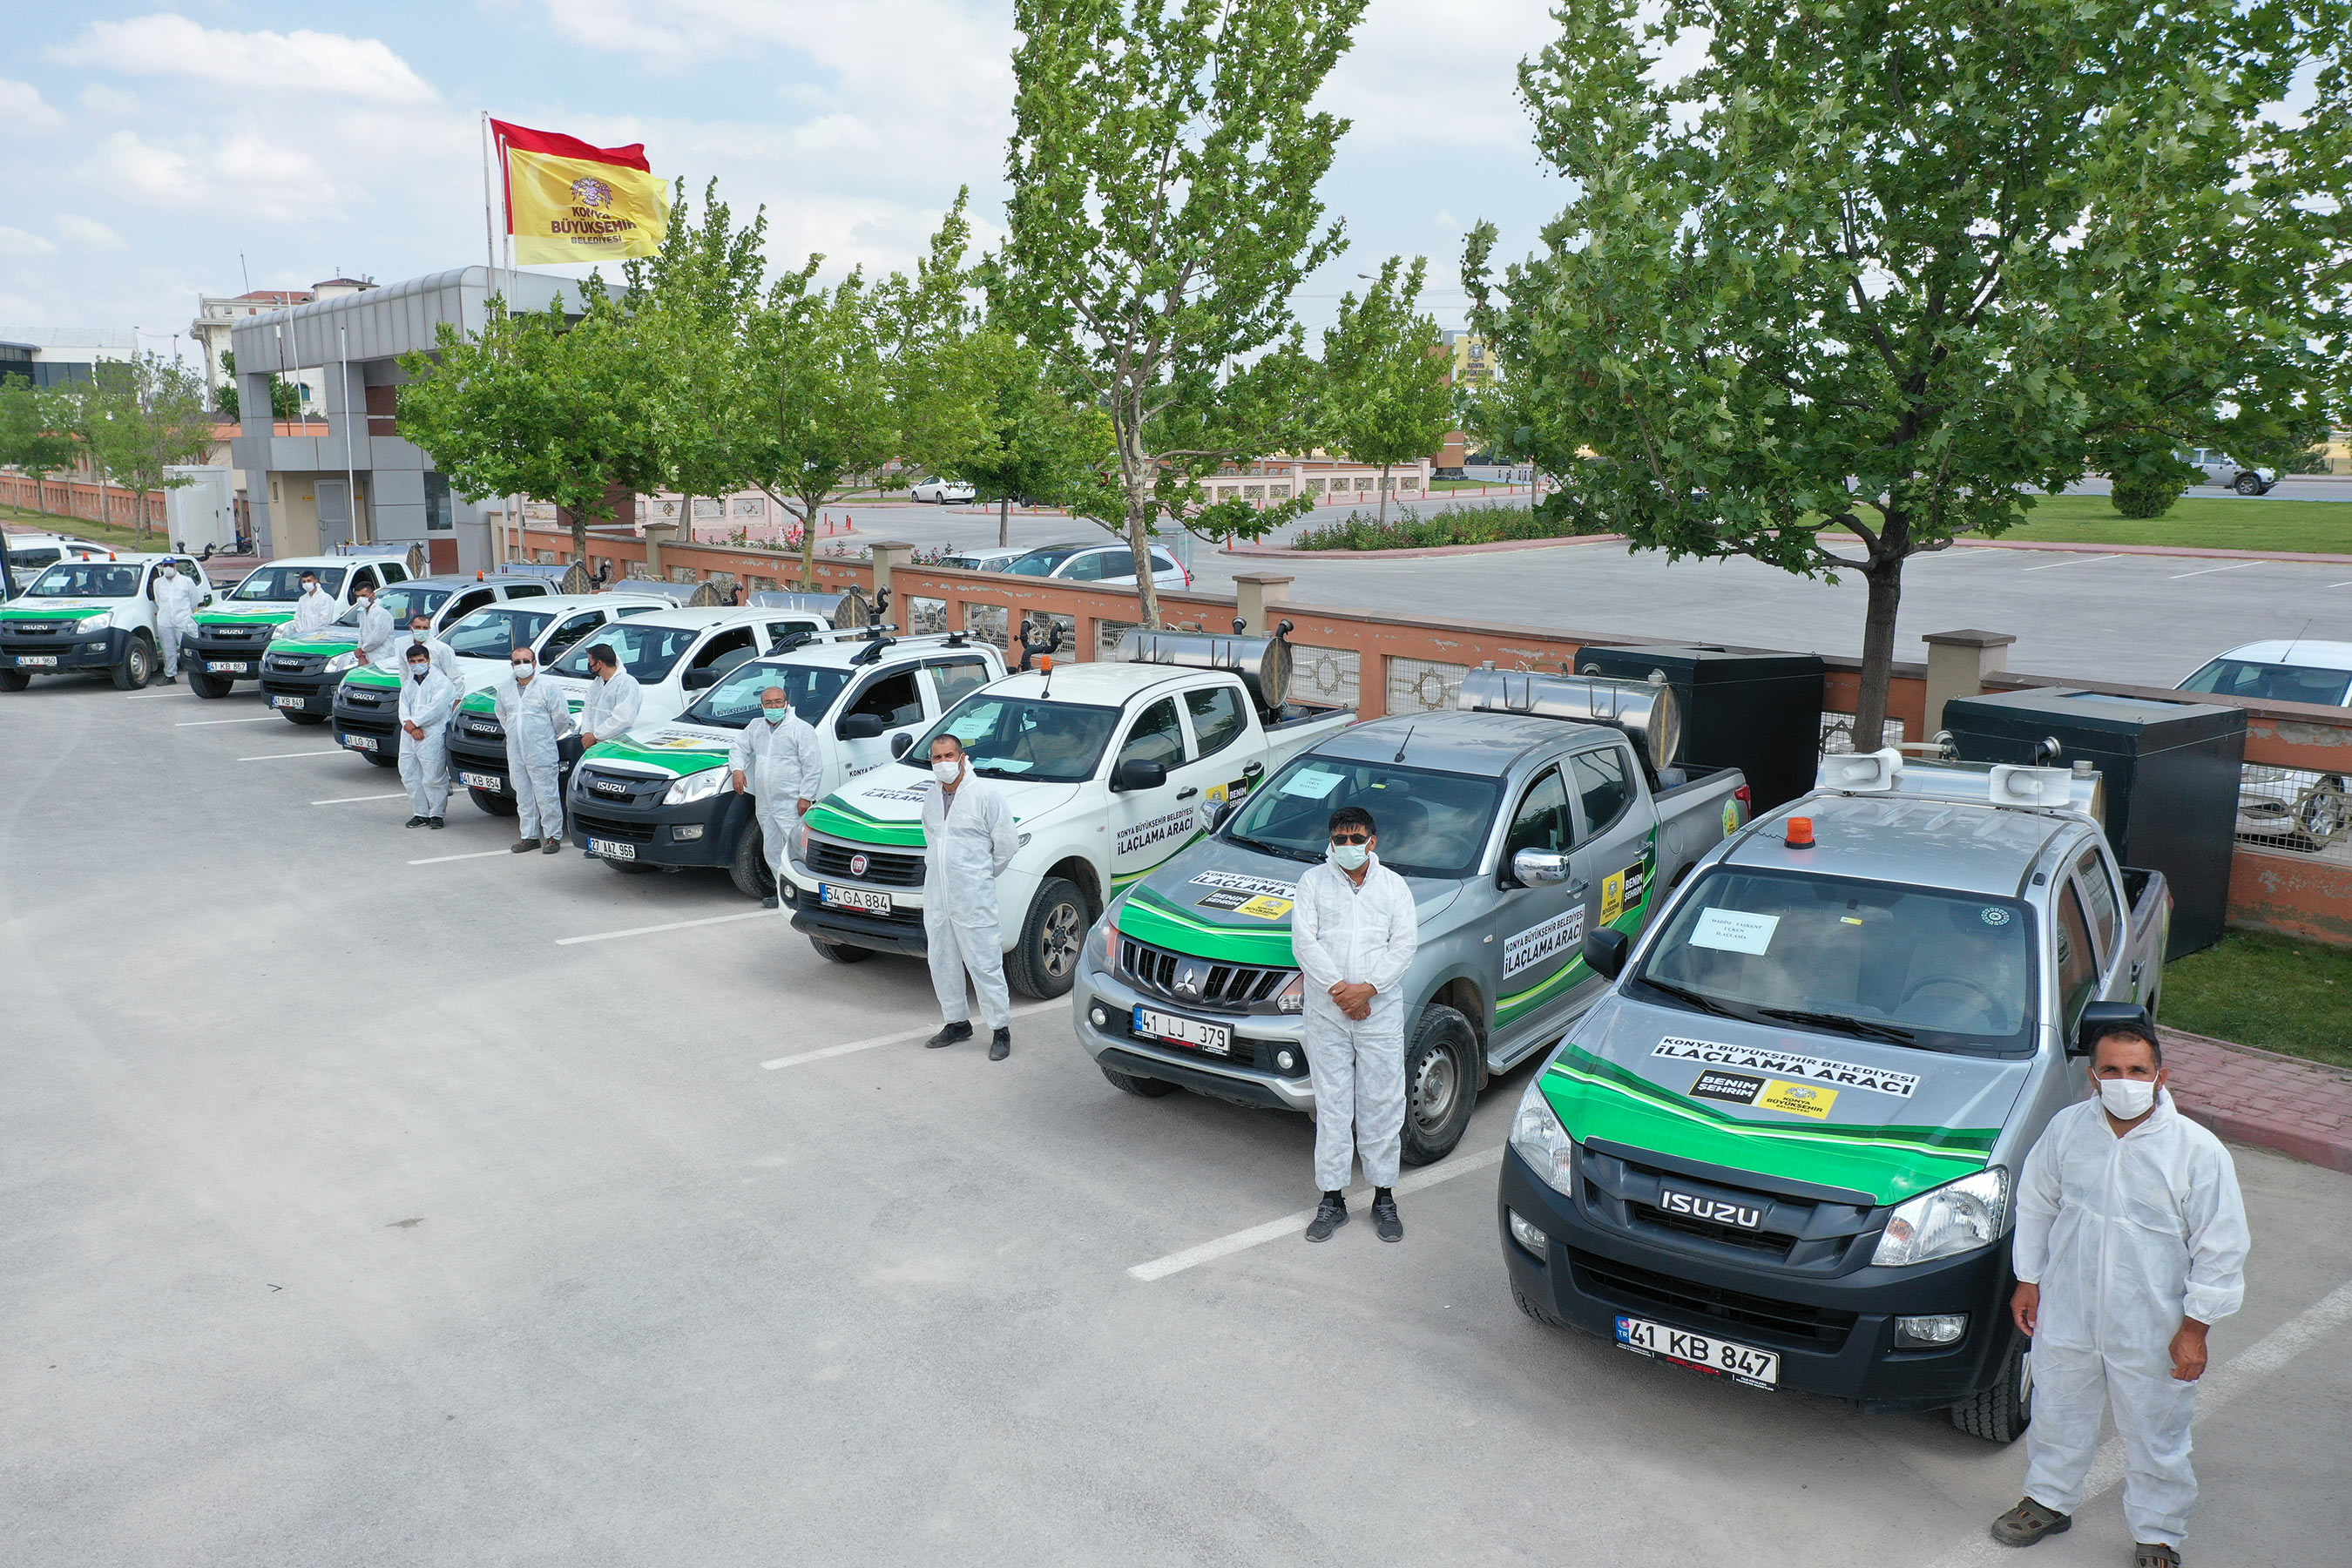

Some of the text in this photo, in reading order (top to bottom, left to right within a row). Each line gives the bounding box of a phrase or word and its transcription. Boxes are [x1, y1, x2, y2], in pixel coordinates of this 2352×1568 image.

[471, 723, 498, 733] ISUZU
[355, 738, 363, 746] LG
[464, 773, 499, 789] 41 KB 854
[849, 768, 868, 777] KONYA
[597, 781, 626, 793] ISUZU
[1117, 827, 1135, 840] KONYA
[1167, 804, 1194, 822] BELEDİYESİ
[1167, 817, 1193, 838] ARACI
[591, 839, 599, 851] 27
[603, 842, 617, 855] AAZ
[619, 845, 633, 857] 966
[1204, 872, 1235, 880] KONYA
[826, 887, 840, 901] 54
[844, 891, 862, 906] GA
[865, 894, 887, 910] 884
[1506, 938, 1524, 954] KONYA
[1557, 907, 1584, 929] BELEDİYESİ
[1554, 922, 1583, 949] ARACI
[1143, 1012, 1157, 1032] 41
[1168, 1018, 1184, 1038] LJ
[1200, 1026, 1225, 1048] 379
[1663, 1038, 1714, 1049] KONYA
[1821, 1061, 1916, 1083] BELEDİYESİ
[1813, 1069, 1912, 1095] ARACI
[1661, 1190, 1760, 1227] ISUZU
[1618, 1329, 1628, 1338] TR
[1630, 1323, 1655, 1348] 41
[1669, 1331, 1709, 1361] KB
[1721, 1345, 1771, 1377] 847
